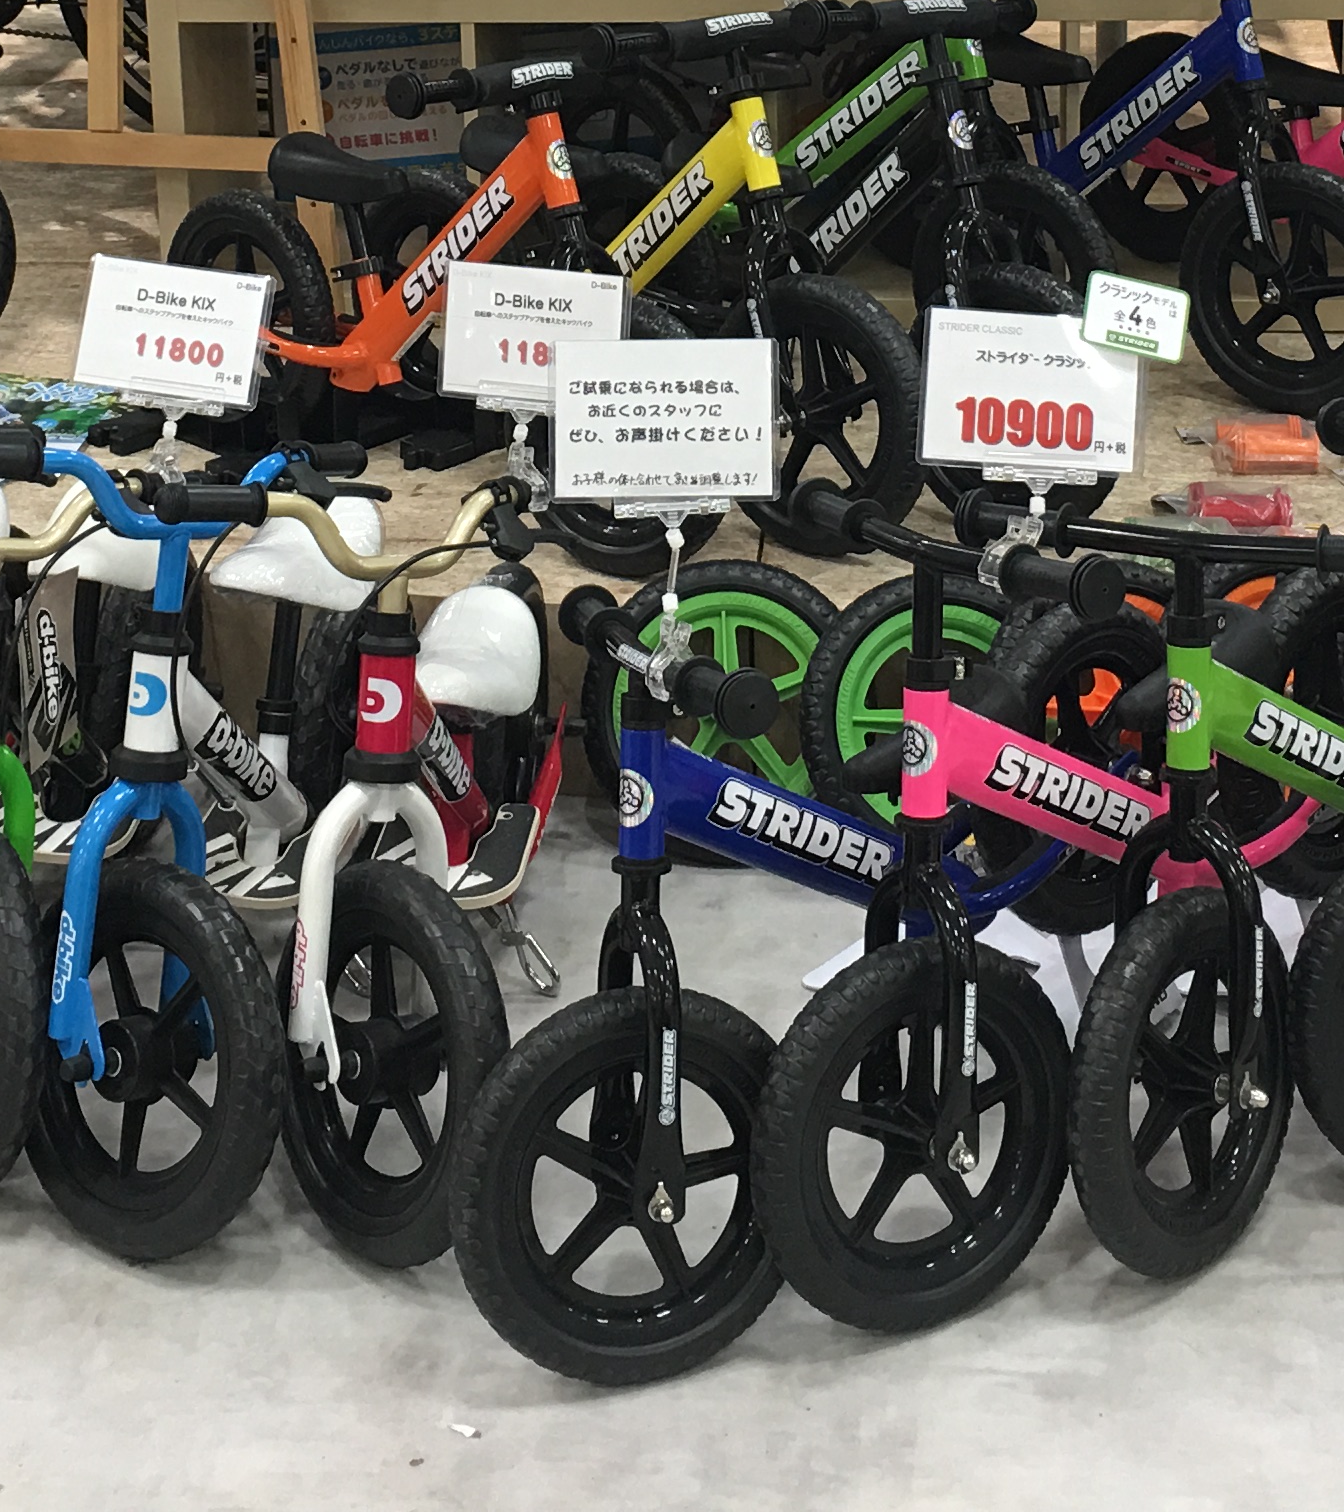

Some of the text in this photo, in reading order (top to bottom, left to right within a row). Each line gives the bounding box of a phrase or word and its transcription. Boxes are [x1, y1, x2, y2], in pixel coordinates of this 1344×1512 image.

[705, 10, 774, 37] STRIDER
[512, 60, 574, 88] STRIDER
[794, 50, 924, 172] STRIDER
[1079, 53, 1200, 178] STRIDER
[340, 128, 437, 150] 自転車に挑戦!
[610, 159, 714, 278] TRIDER
[401, 173, 515, 319] STRIDER
[236, 281, 262, 292] D-Bike
[590, 281, 618, 290] D-Bike
[1099, 281, 1178, 309] クラシックモデル
[137, 287, 218, 313] D-Bike KIX
[494, 292, 573, 314] D-Bike KIX
[939, 322, 1023, 336] STRIDER CLASSIC
[1114, 306, 1156, 330] 全4色
[135, 332, 224, 368] 11800
[1118, 335, 1156, 349] STRIDER
[976, 349, 1040, 364] ストライダー
[214, 371, 243, 386] 円+税
[568, 379, 741, 396] ご試乗になられる場合は、
[588, 403, 723, 418] お近くのスタッフに
[956, 396, 1094, 452] 10900
[1093, 441, 1127, 455] 円+税
[986, 743, 1153, 839] STRIDER
[706, 778, 896, 883] STRIDER
[965, 981, 977, 1059] STRIDER
[661, 1028, 677, 1106] STRIDER
